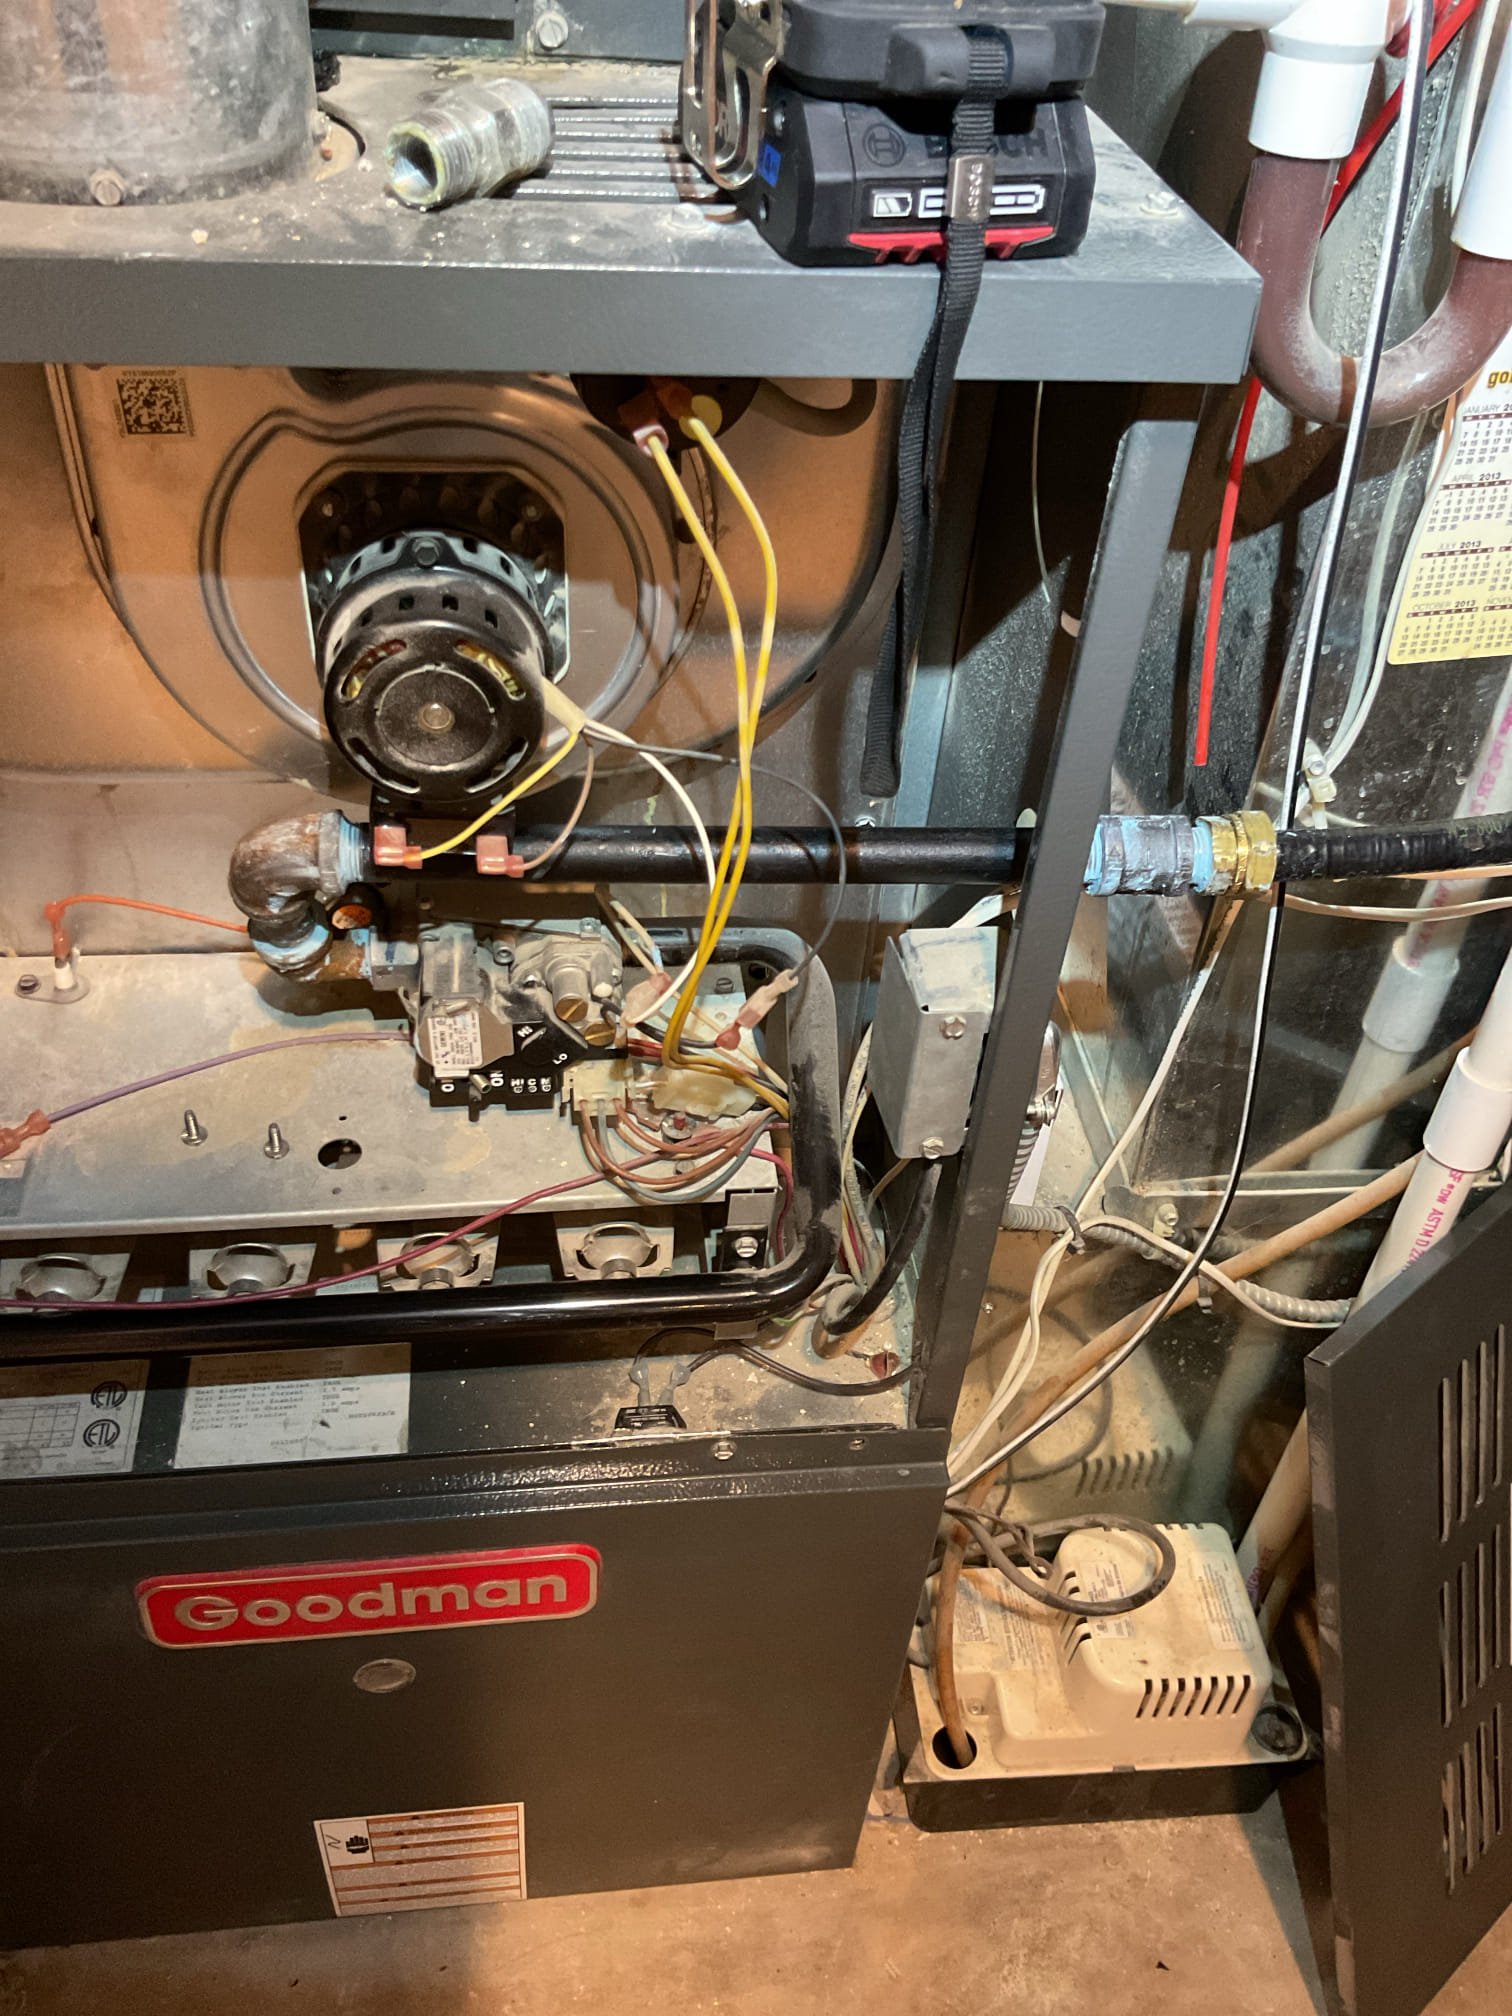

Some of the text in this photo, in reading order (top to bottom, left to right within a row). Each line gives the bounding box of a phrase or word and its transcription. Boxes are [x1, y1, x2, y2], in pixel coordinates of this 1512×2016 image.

[1479, 472, 1501, 481] 2013
[1460, 540, 1481, 549] 2013
[1455, 600, 1476, 608] 2013
[517, 1026, 533, 1037] HI
[552, 1053, 568, 1065] LO
[1419, 1207, 1444, 1238] ASTM
[174, 1574, 567, 1632] Goodman
